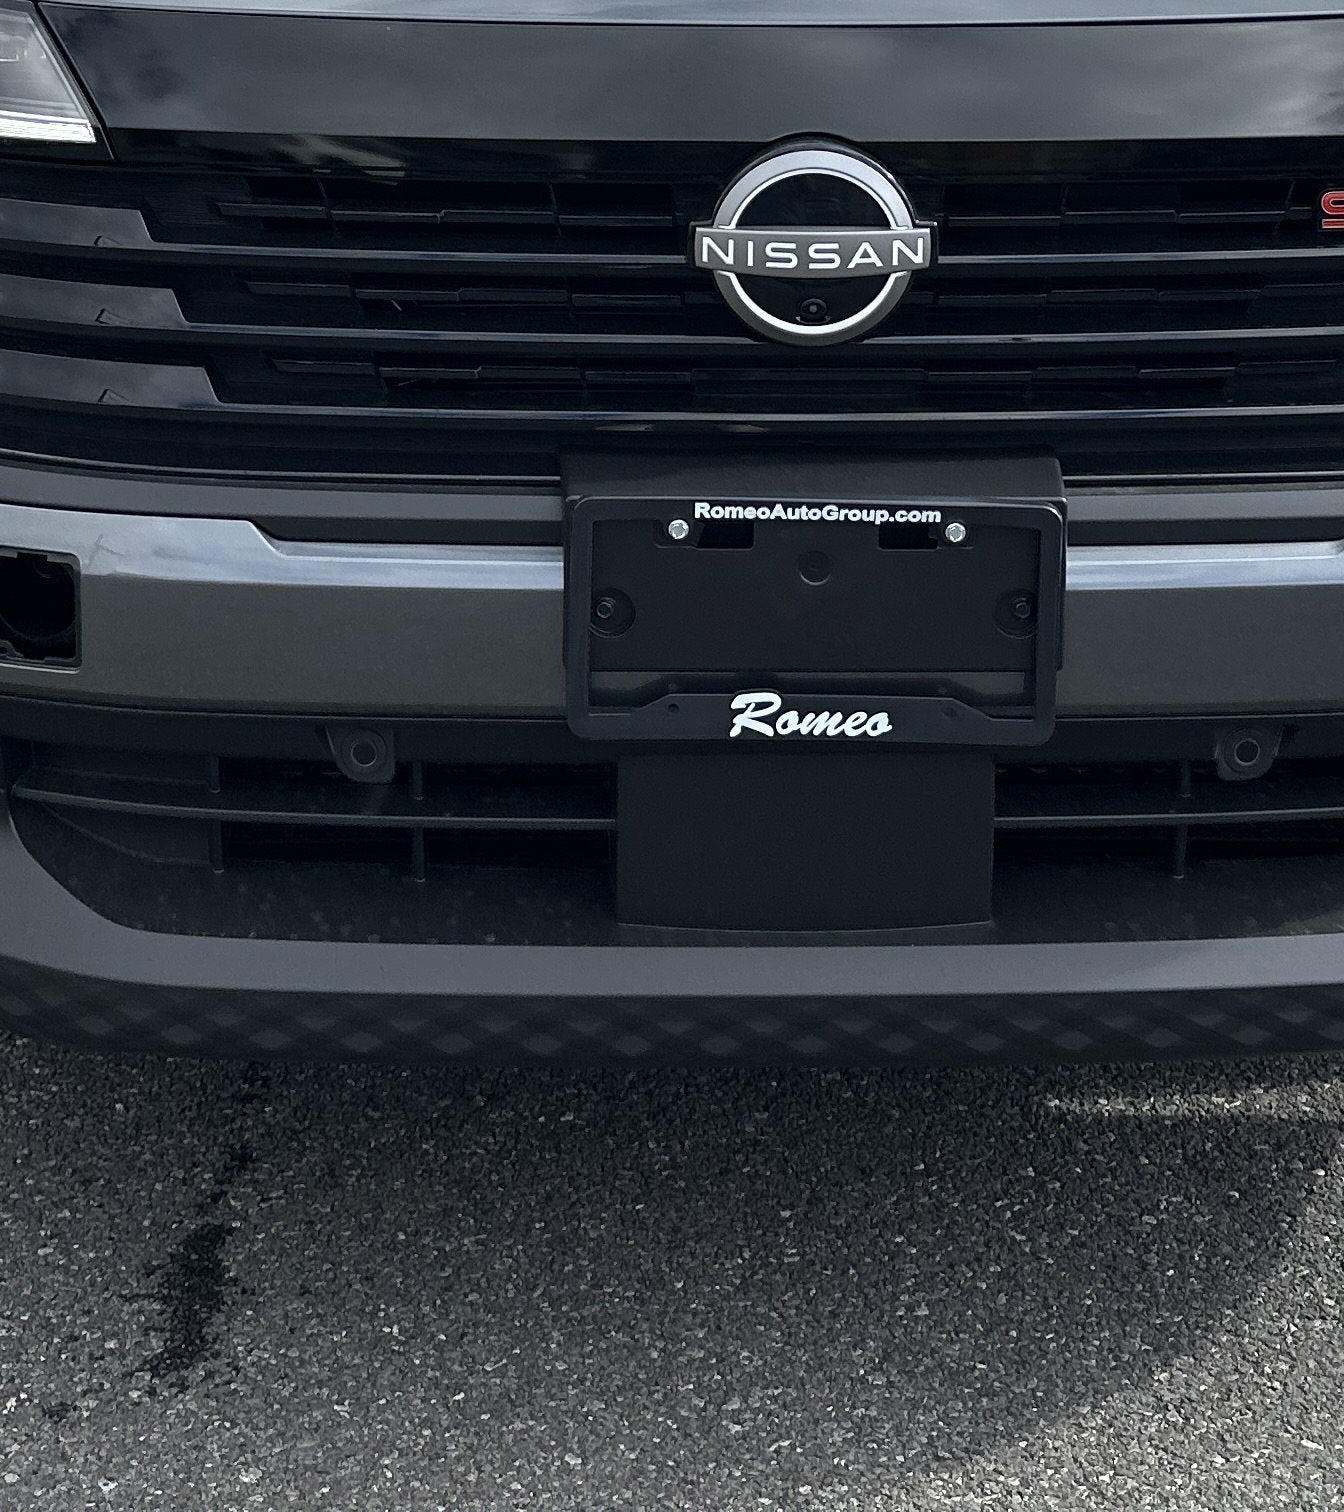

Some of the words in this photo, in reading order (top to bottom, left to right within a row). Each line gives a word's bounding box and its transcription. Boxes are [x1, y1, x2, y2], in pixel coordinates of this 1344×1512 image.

[702, 236, 924, 270] NISSAN
[694, 502, 942, 525] RomeoAutoGroup.com
[729, 692, 893, 737] Romeo
